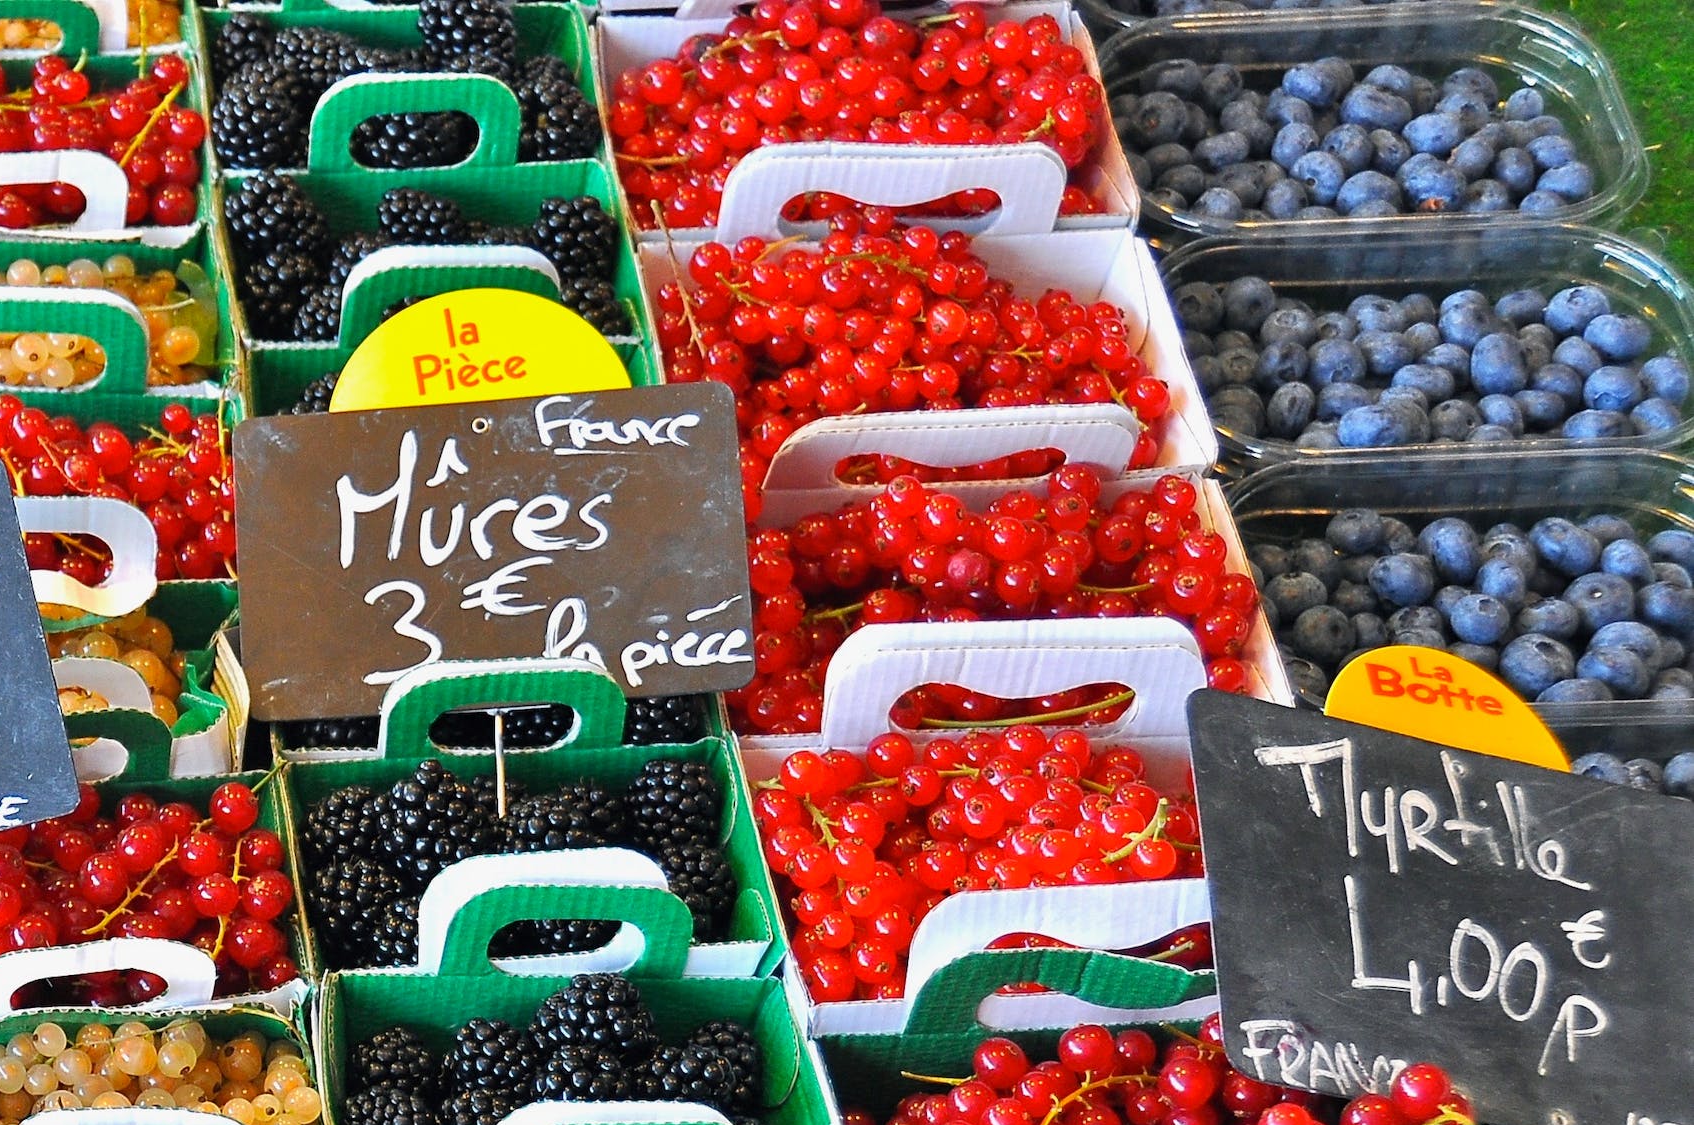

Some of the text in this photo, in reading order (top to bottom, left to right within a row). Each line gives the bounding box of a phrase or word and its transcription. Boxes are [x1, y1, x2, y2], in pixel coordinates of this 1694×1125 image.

[443, 307, 480, 348] la
[412, 352, 528, 397] Pièce
[534, 395, 701, 449] France
[336, 430, 613, 570] Mûres
[1364, 662, 1504, 716] Botte
[1408, 655, 1454, 684] La
